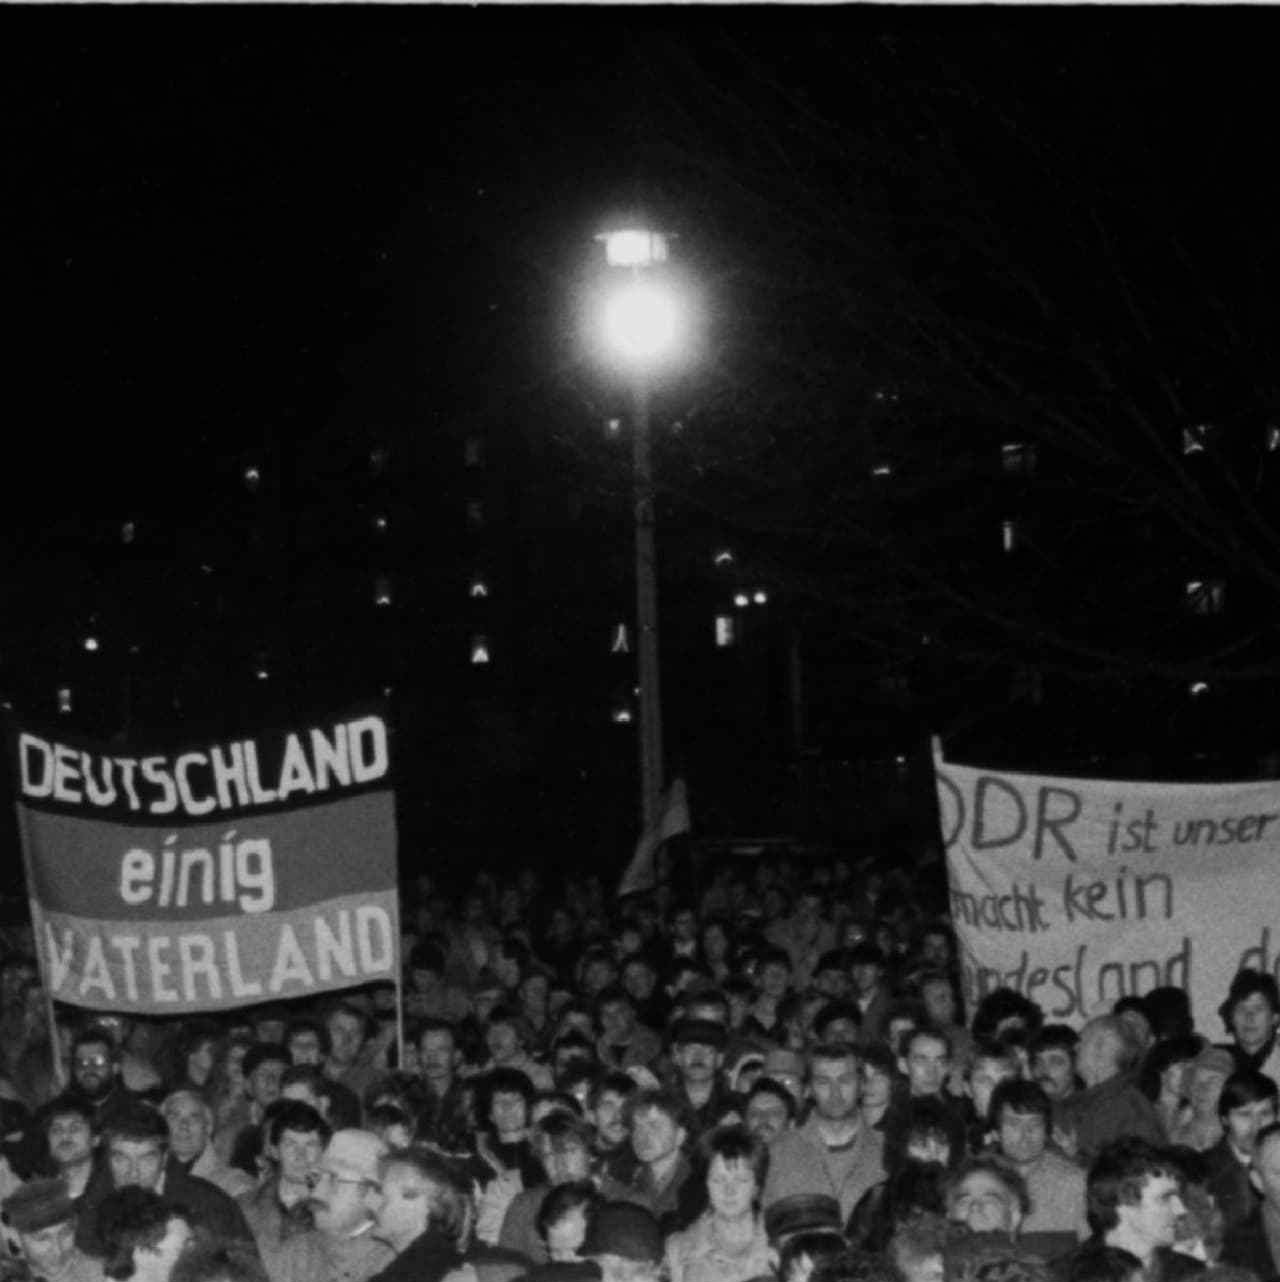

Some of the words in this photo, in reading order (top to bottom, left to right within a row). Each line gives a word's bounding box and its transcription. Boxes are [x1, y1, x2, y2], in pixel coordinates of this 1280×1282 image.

[19, 715, 390, 816] DEUTSCHLAND
[936, 770, 1078, 863] DDR
[1106, 800, 1160, 856] ist
[120, 829, 276, 914] einig
[951, 880, 1052, 934] macht
[1062, 866, 1176, 924] kein
[44, 905, 395, 1003] VATERLAND
